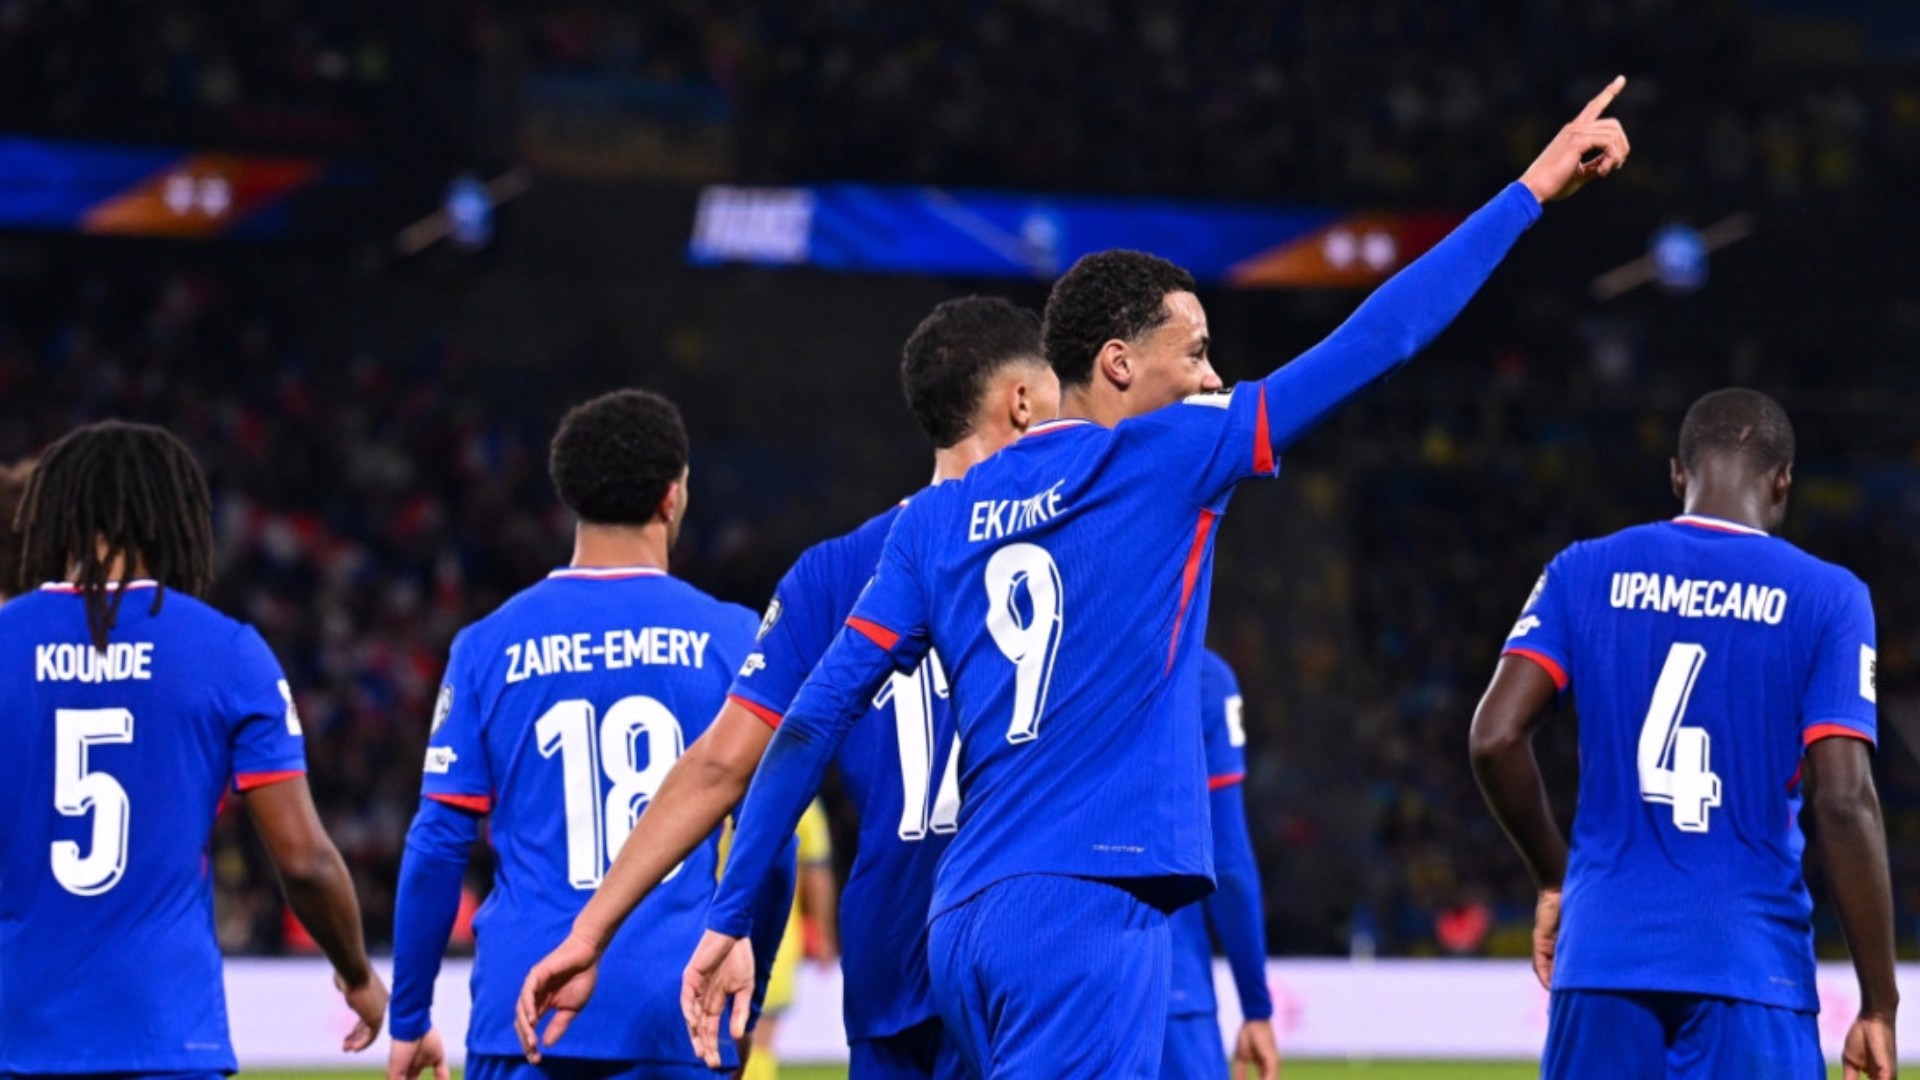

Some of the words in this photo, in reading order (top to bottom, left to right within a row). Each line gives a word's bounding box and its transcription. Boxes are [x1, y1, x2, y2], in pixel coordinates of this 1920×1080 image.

[35, 642, 154, 684] KOUNDE
[505, 626, 711, 684] ZAIRE-EMERY
[984, 542, 1064, 745] 9
[1610, 571, 1788, 625] UPAMECANO
[50, 707, 135, 897] 5
[534, 694, 685, 890] 18
[1637, 642, 1722, 833] 4
